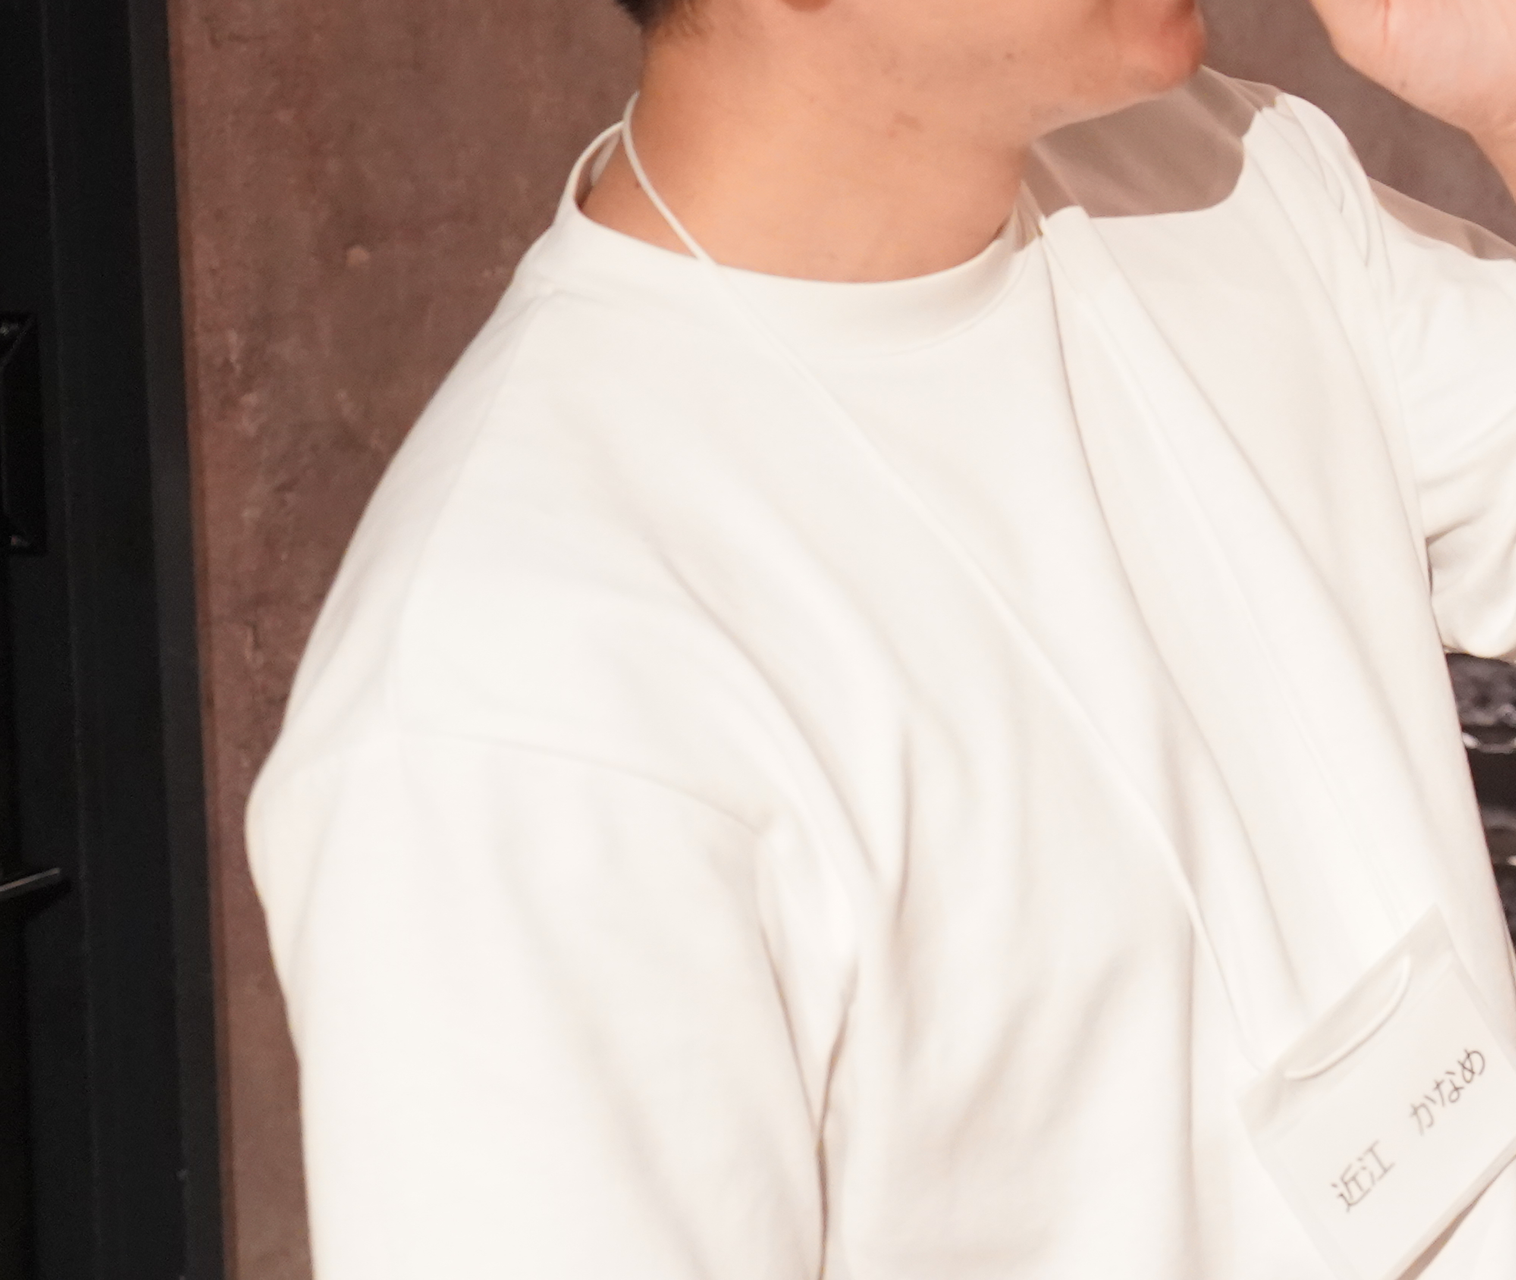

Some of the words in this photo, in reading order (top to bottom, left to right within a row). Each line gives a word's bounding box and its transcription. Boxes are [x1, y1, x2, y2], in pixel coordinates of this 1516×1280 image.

[1330, 1139, 1396, 1213] 近江
[1408, 1046, 1487, 1136] かなめ
